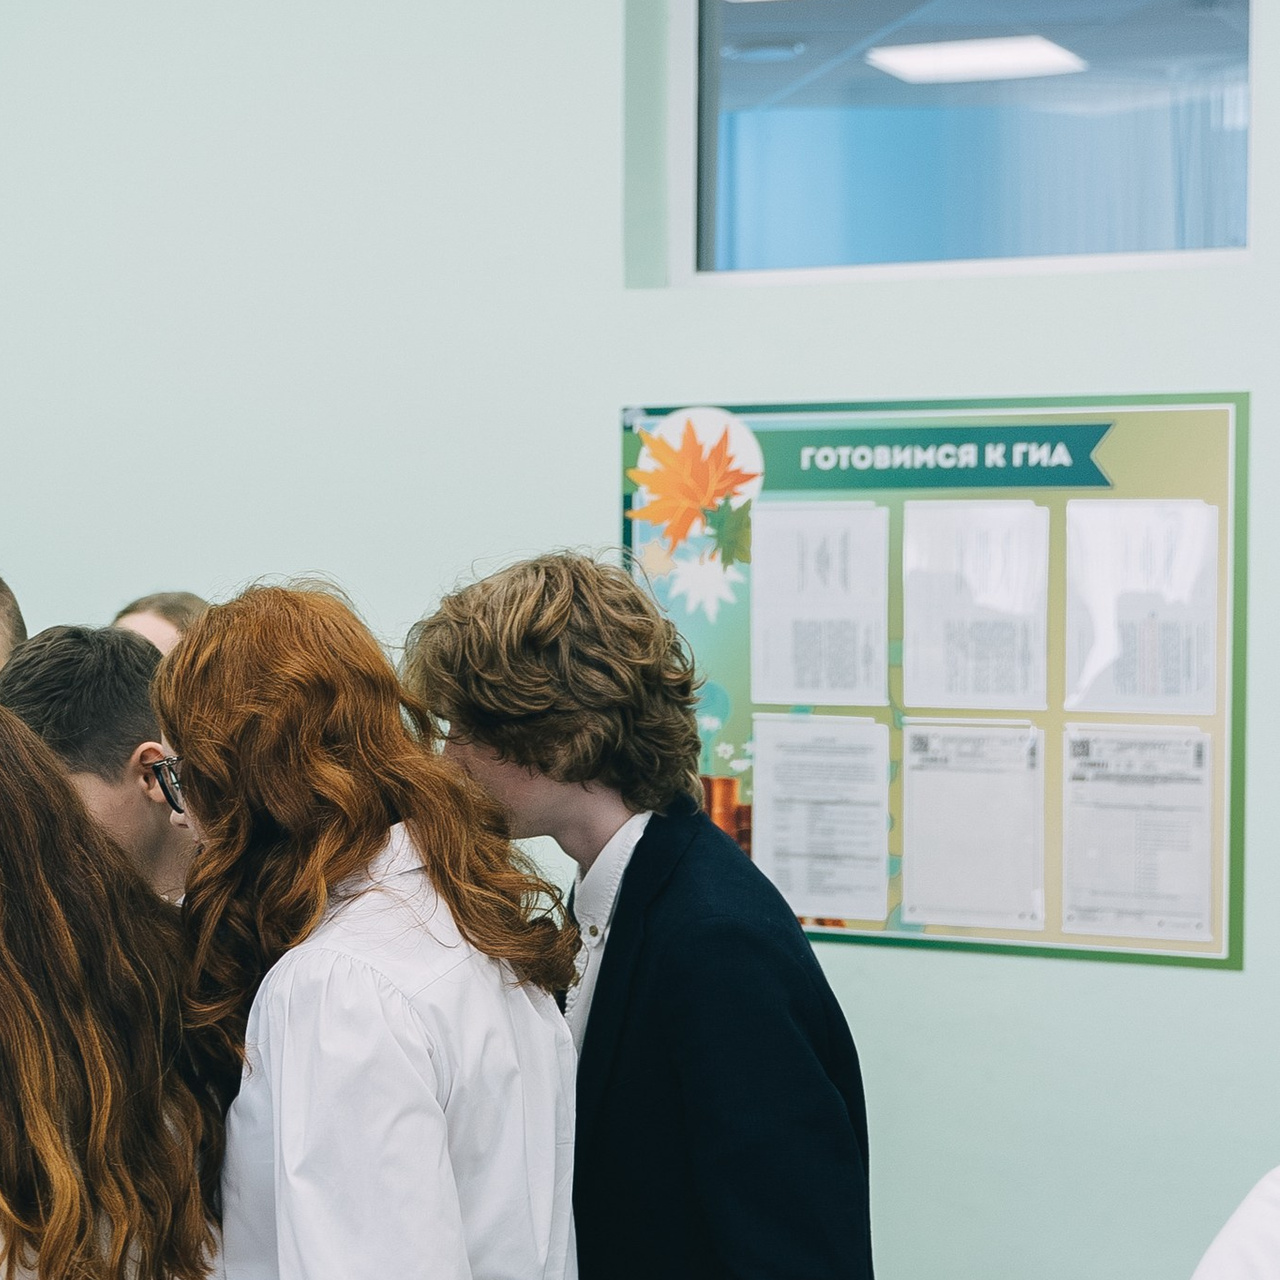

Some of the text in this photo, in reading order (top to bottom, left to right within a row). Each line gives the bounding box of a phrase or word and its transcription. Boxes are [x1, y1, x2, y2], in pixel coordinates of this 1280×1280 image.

[799, 440, 1074, 471] ГОТОВИМСЯ К ГИА
